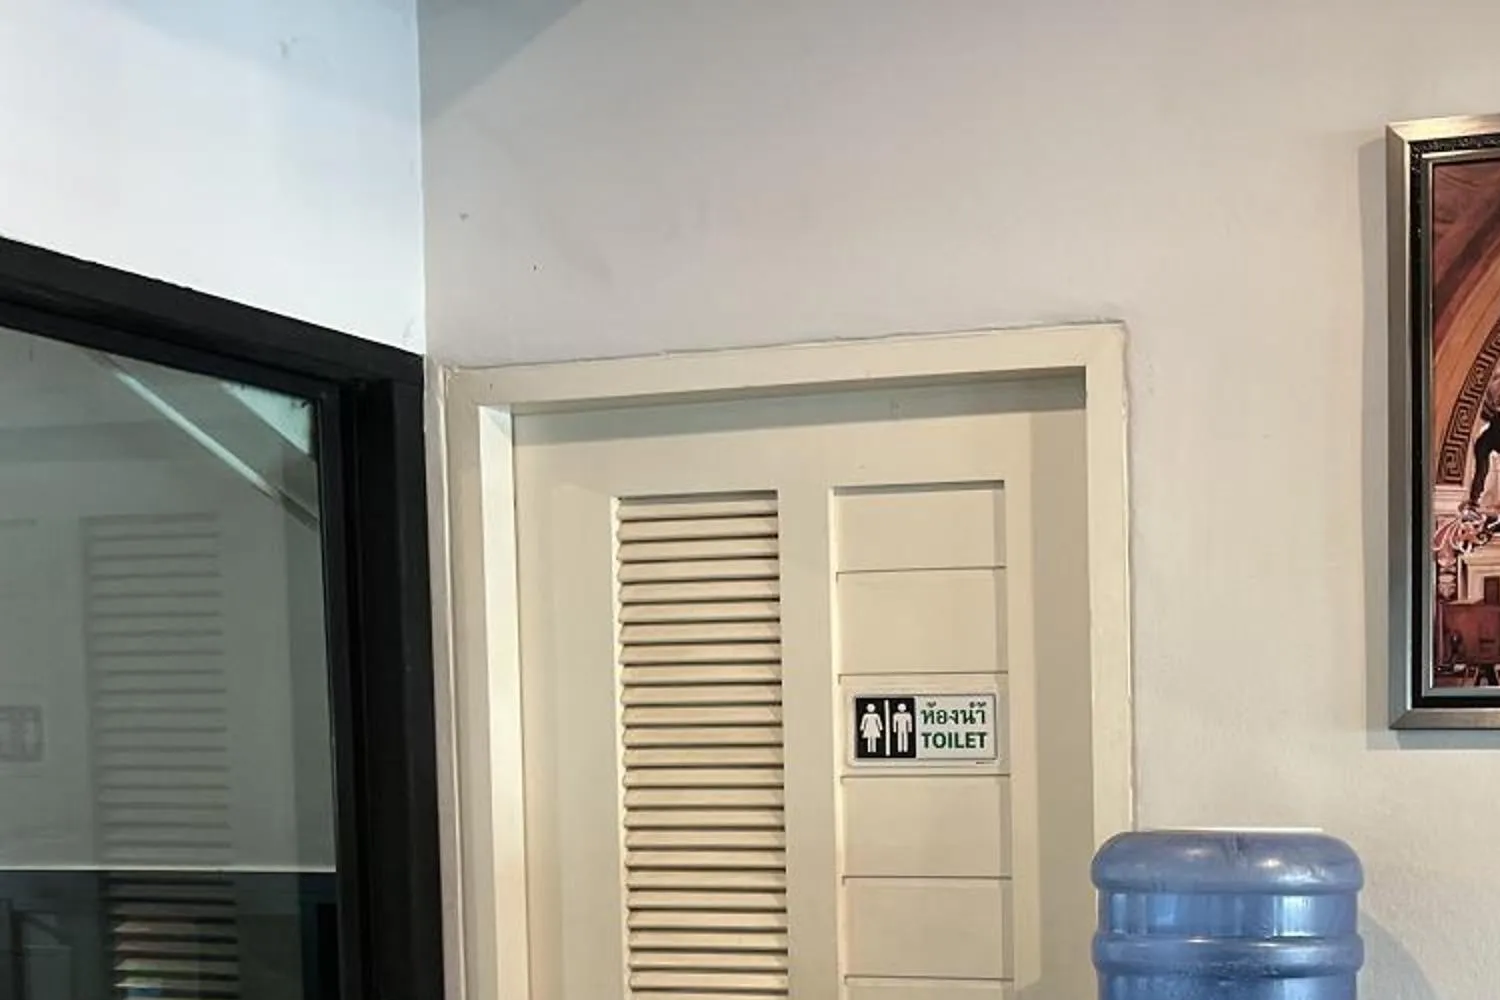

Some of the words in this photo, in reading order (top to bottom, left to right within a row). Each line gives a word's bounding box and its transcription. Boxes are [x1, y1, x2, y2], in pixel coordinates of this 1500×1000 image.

[920, 701, 986, 724] ห้องน้ำ
[921, 732, 987, 748] TOILET
